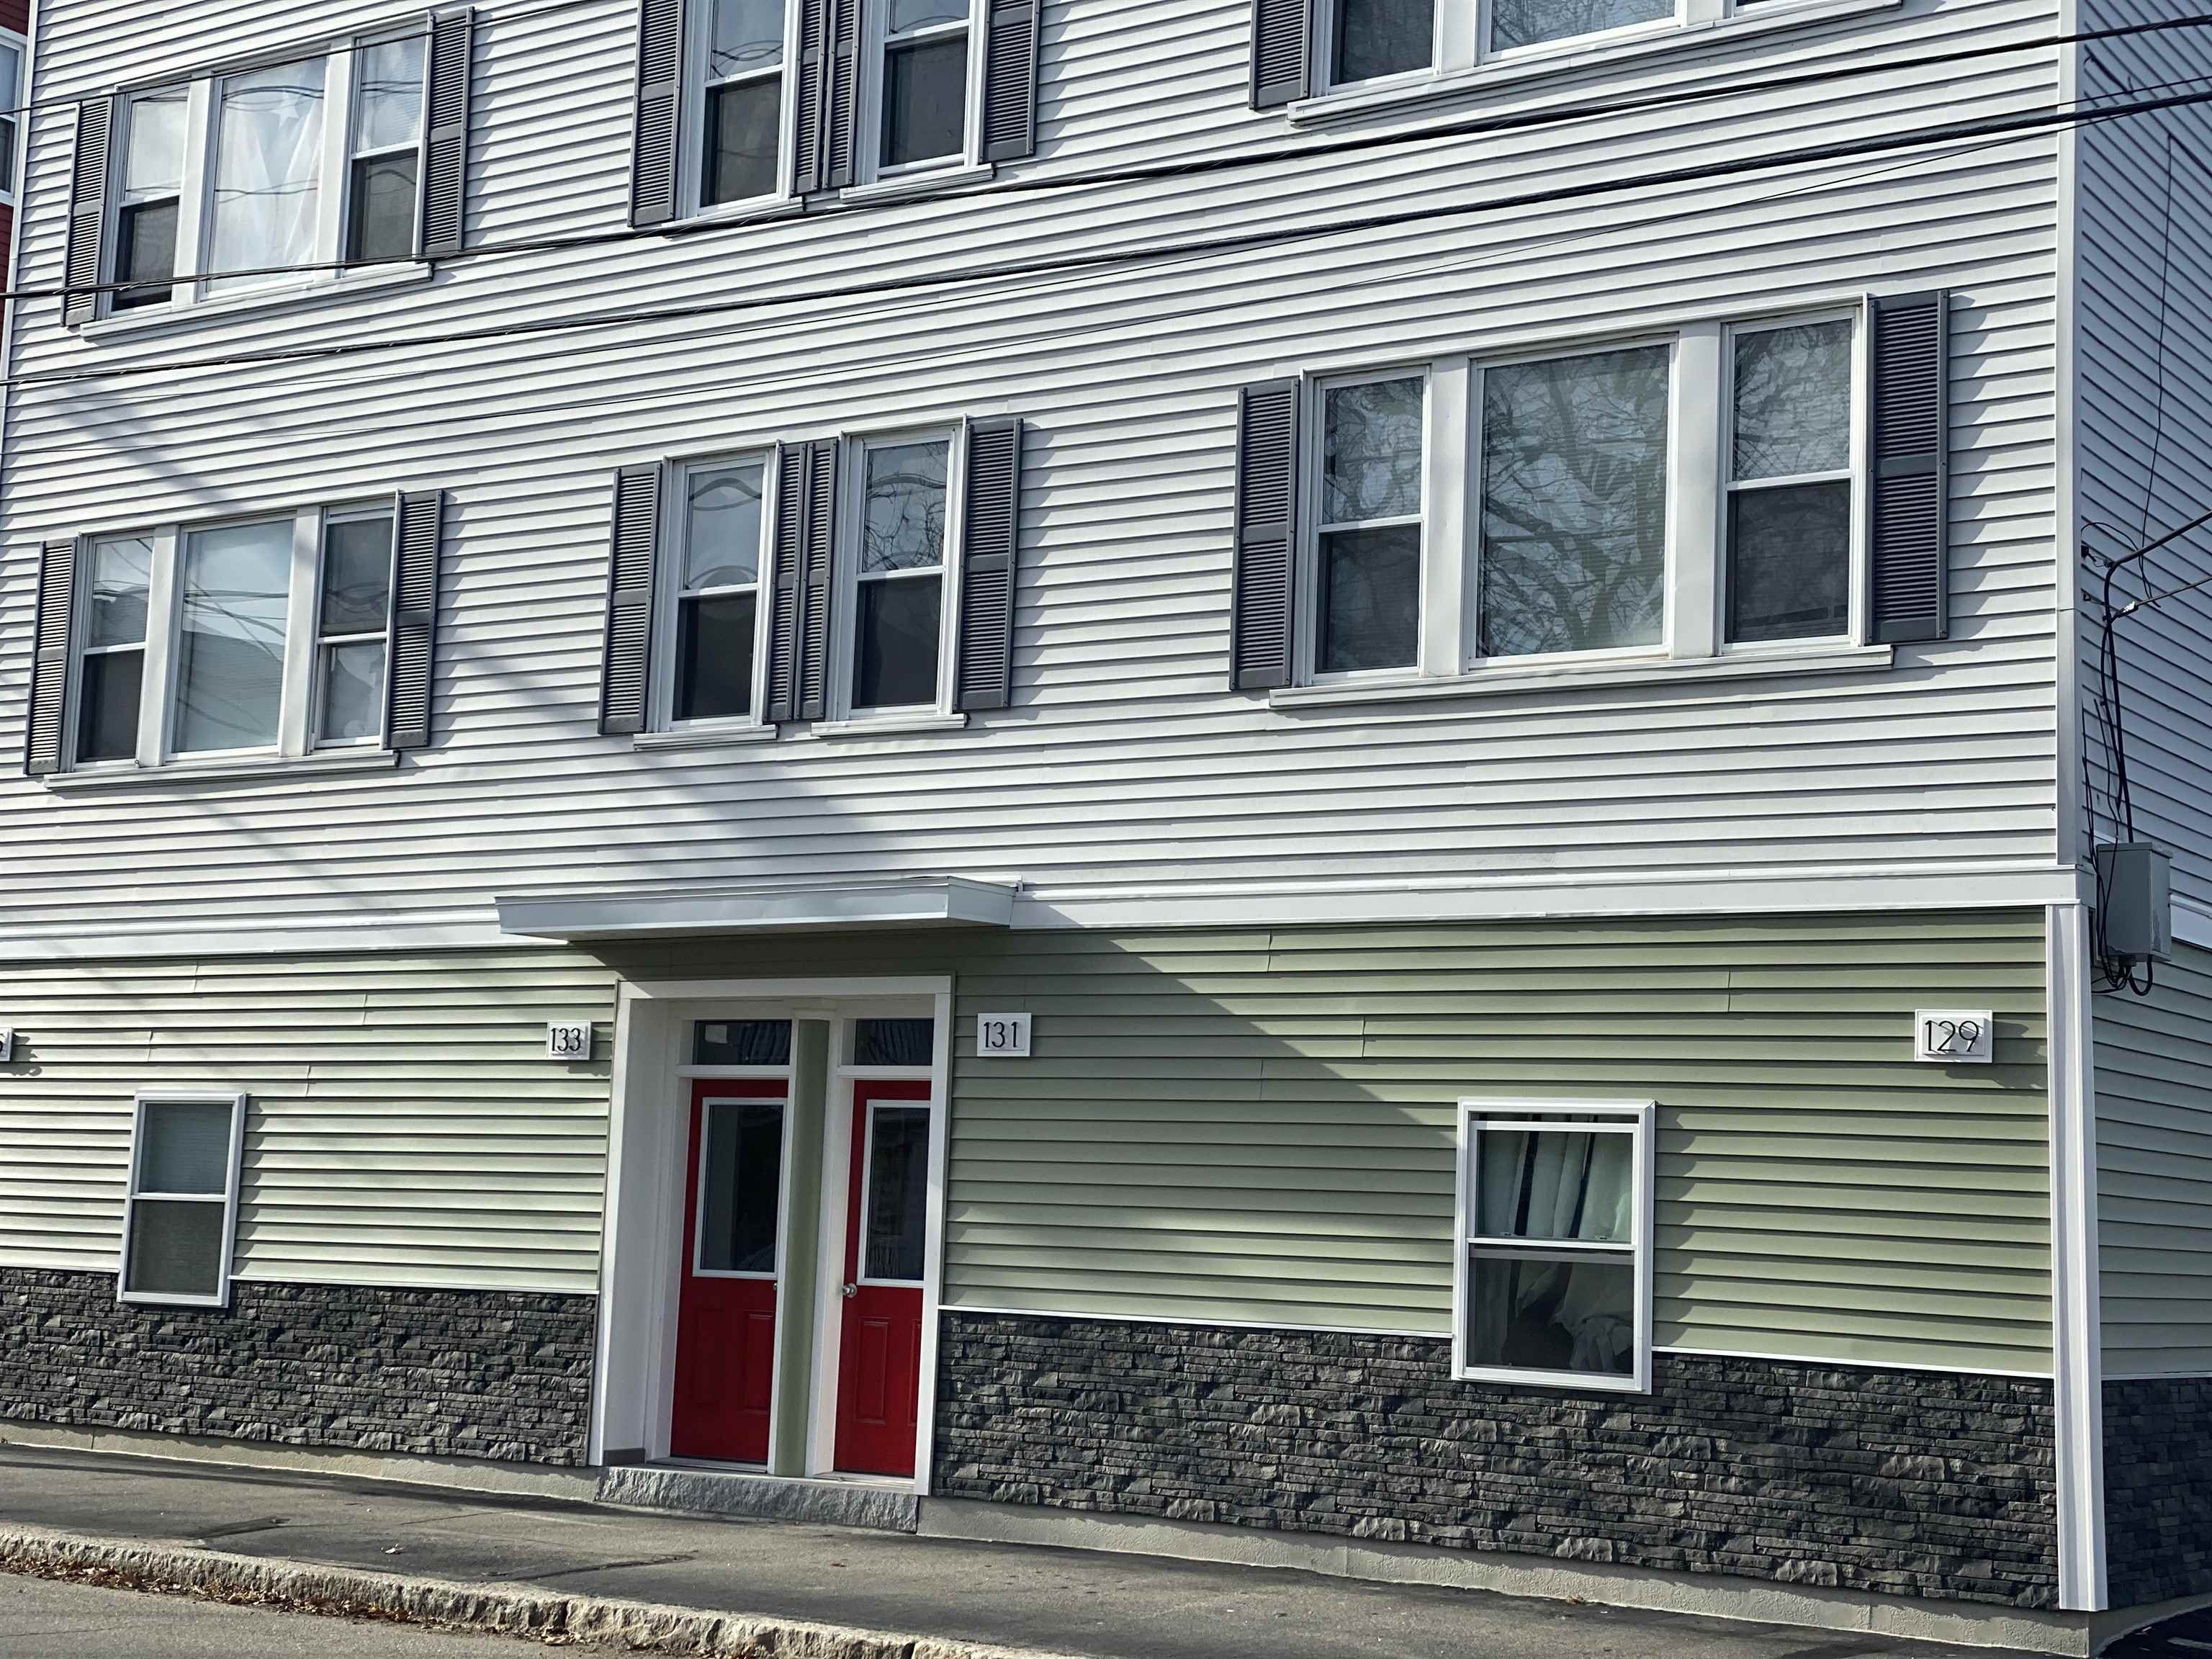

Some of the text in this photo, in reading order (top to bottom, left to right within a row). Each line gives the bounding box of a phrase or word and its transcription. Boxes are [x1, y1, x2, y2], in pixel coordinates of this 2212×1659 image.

[551, 1028, 581, 1051] 133
[984, 1021, 1017, 1048] 131
[1925, 1020, 1979, 1052] 129
